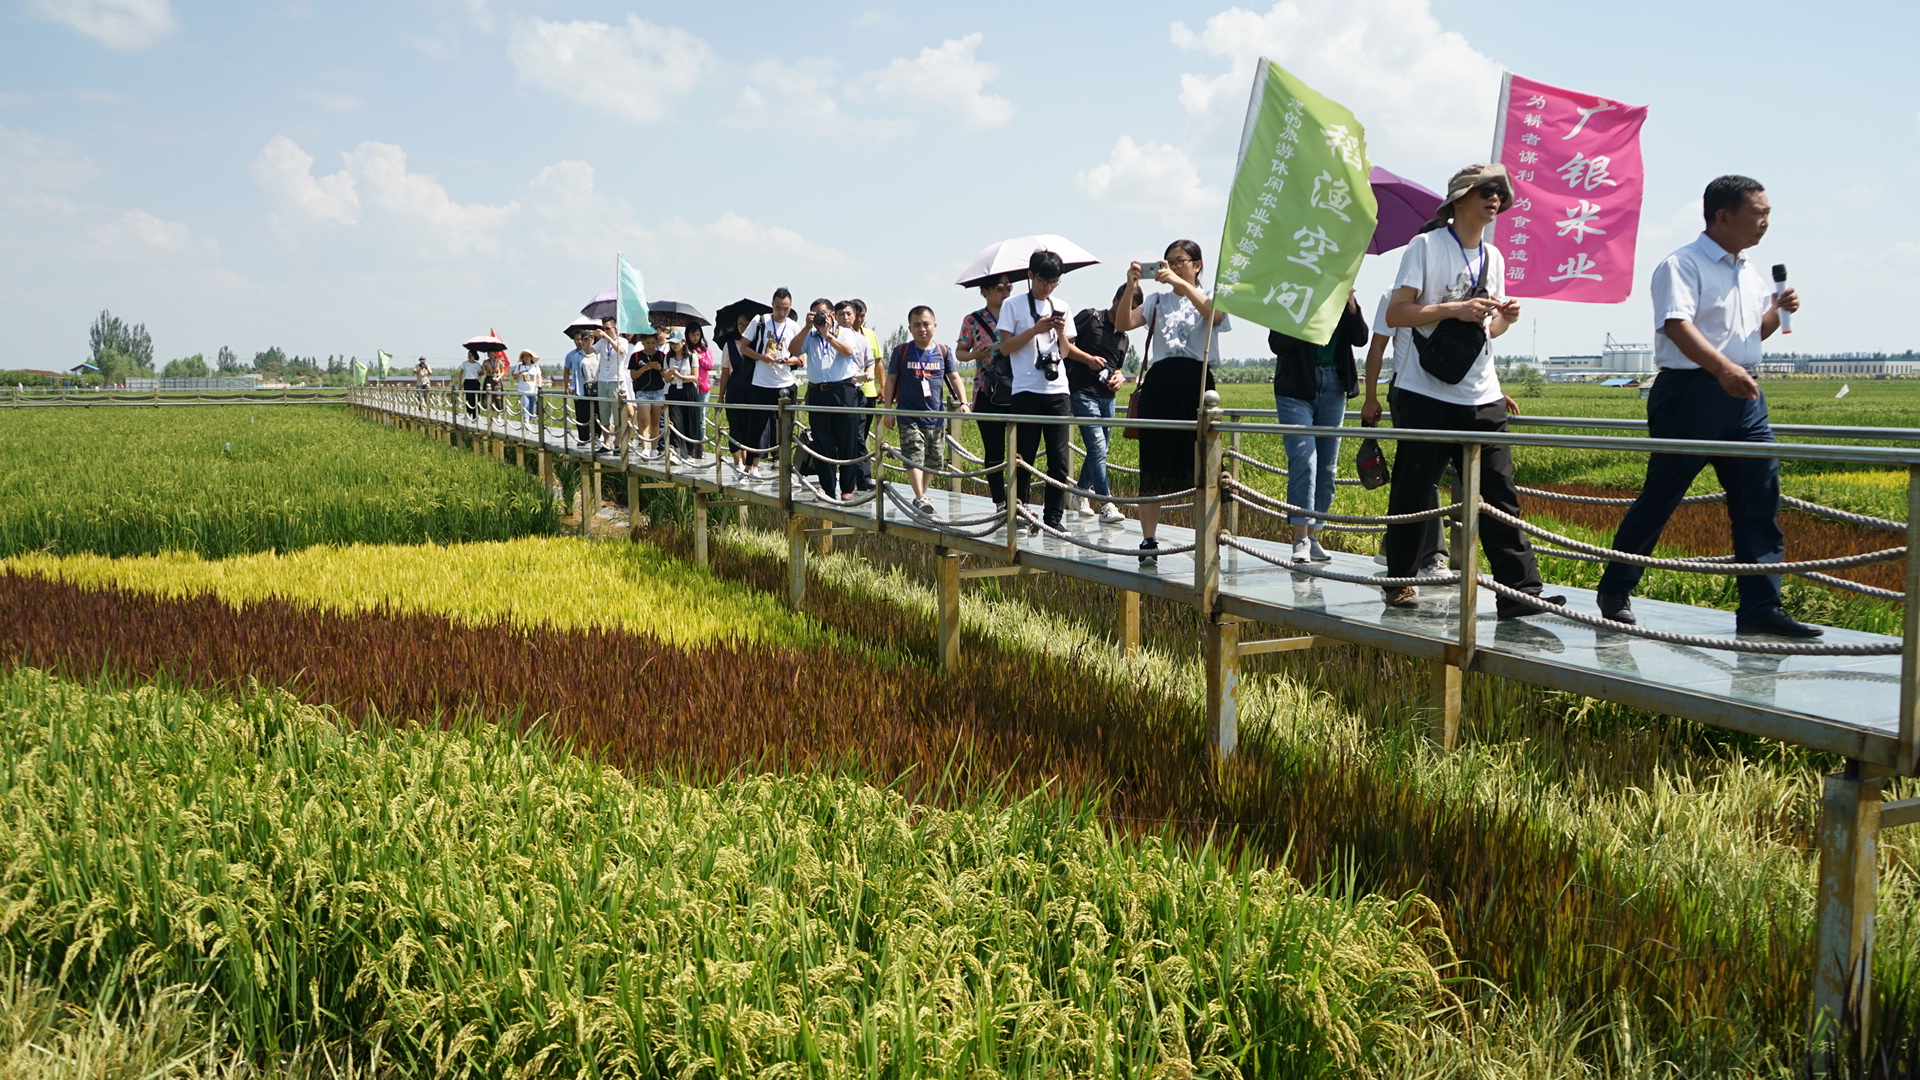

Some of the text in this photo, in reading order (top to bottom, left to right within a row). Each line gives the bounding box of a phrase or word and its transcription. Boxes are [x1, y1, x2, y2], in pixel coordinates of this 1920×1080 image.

[1262, 123, 1363, 324] 稻渔空间
[1506, 94, 1546, 280] 为耕者谋利 为食者造福
[1549, 98, 1617, 282] 广银米业
